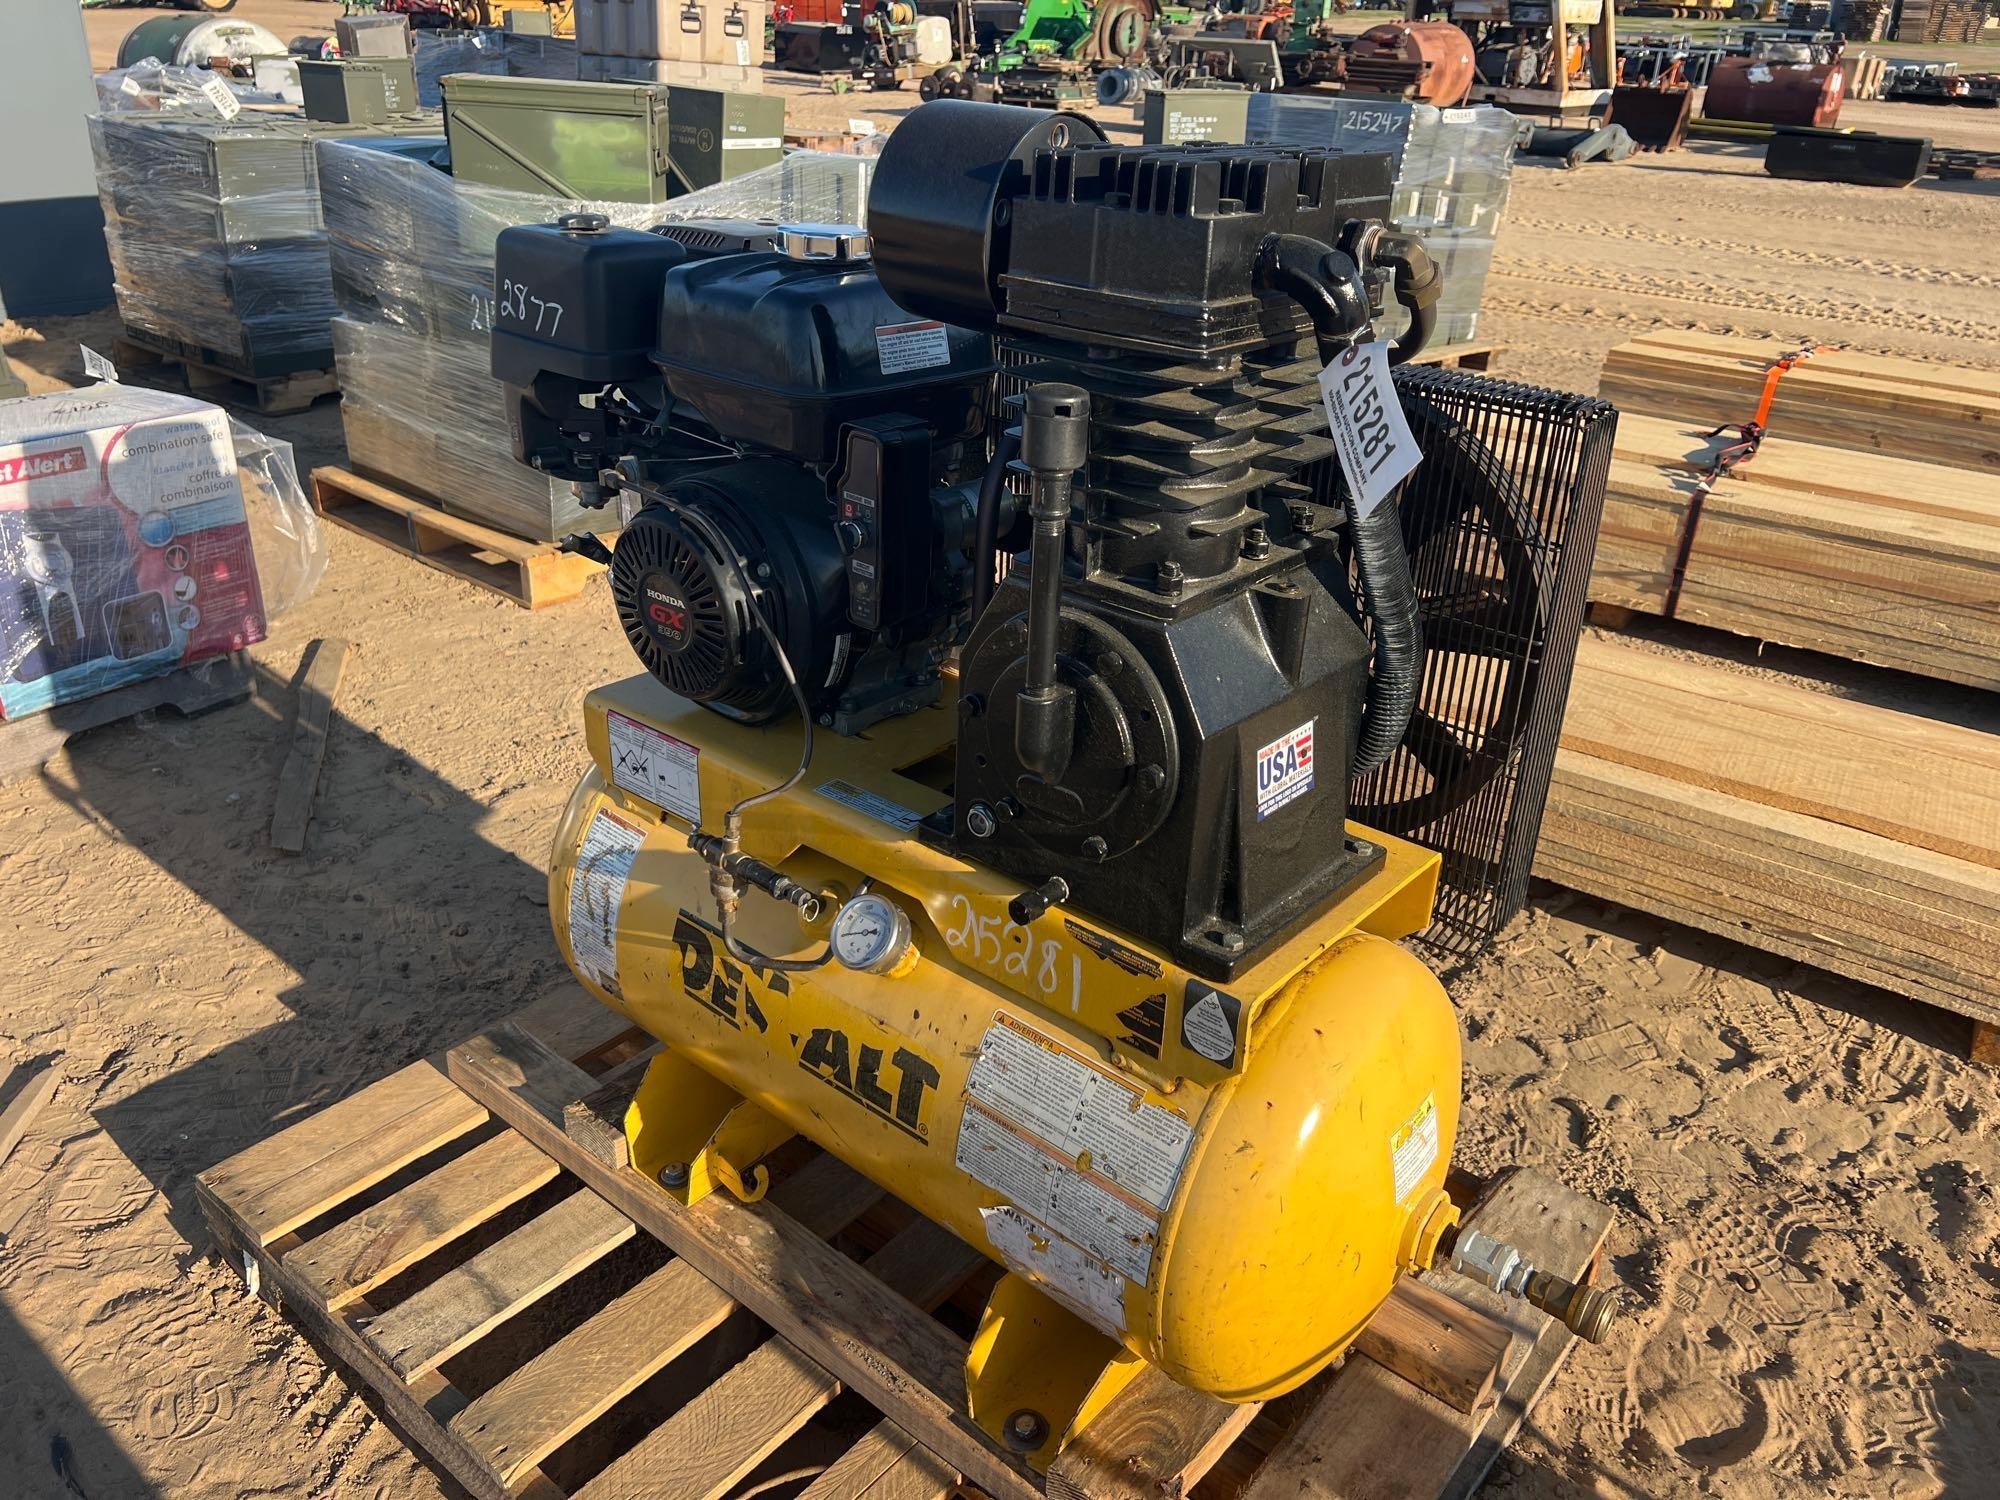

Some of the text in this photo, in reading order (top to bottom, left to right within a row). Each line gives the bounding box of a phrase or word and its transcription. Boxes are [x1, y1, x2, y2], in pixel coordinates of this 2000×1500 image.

[1342, 110, 1403, 134] 215247
[501, 278, 563, 336] 2877
[165, 416, 221, 435] waterproof
[1343, 356, 1396, 475] 215281
[121, 430, 223, 458] combination safe
[1336, 390, 1368, 486] REBEL AUCTION COMPANY
[18, 453, 73, 479] Alert
[189, 470, 221, 483] coffre
[160, 480, 234, 503] combinaison
[646, 588, 686, 609] HONDA
[650, 604, 686, 630] GX
[1260, 744, 1298, 791] USA
[1260, 788, 1271, 800] WITH
[1289, 766, 1312, 783] MATERIALS
[946, 894, 1083, 1013] 215281
[1008, 1020, 1054, 1049] ADVERTENCIA
[971, 1101, 1018, 1135] AVERTISSEMENT
